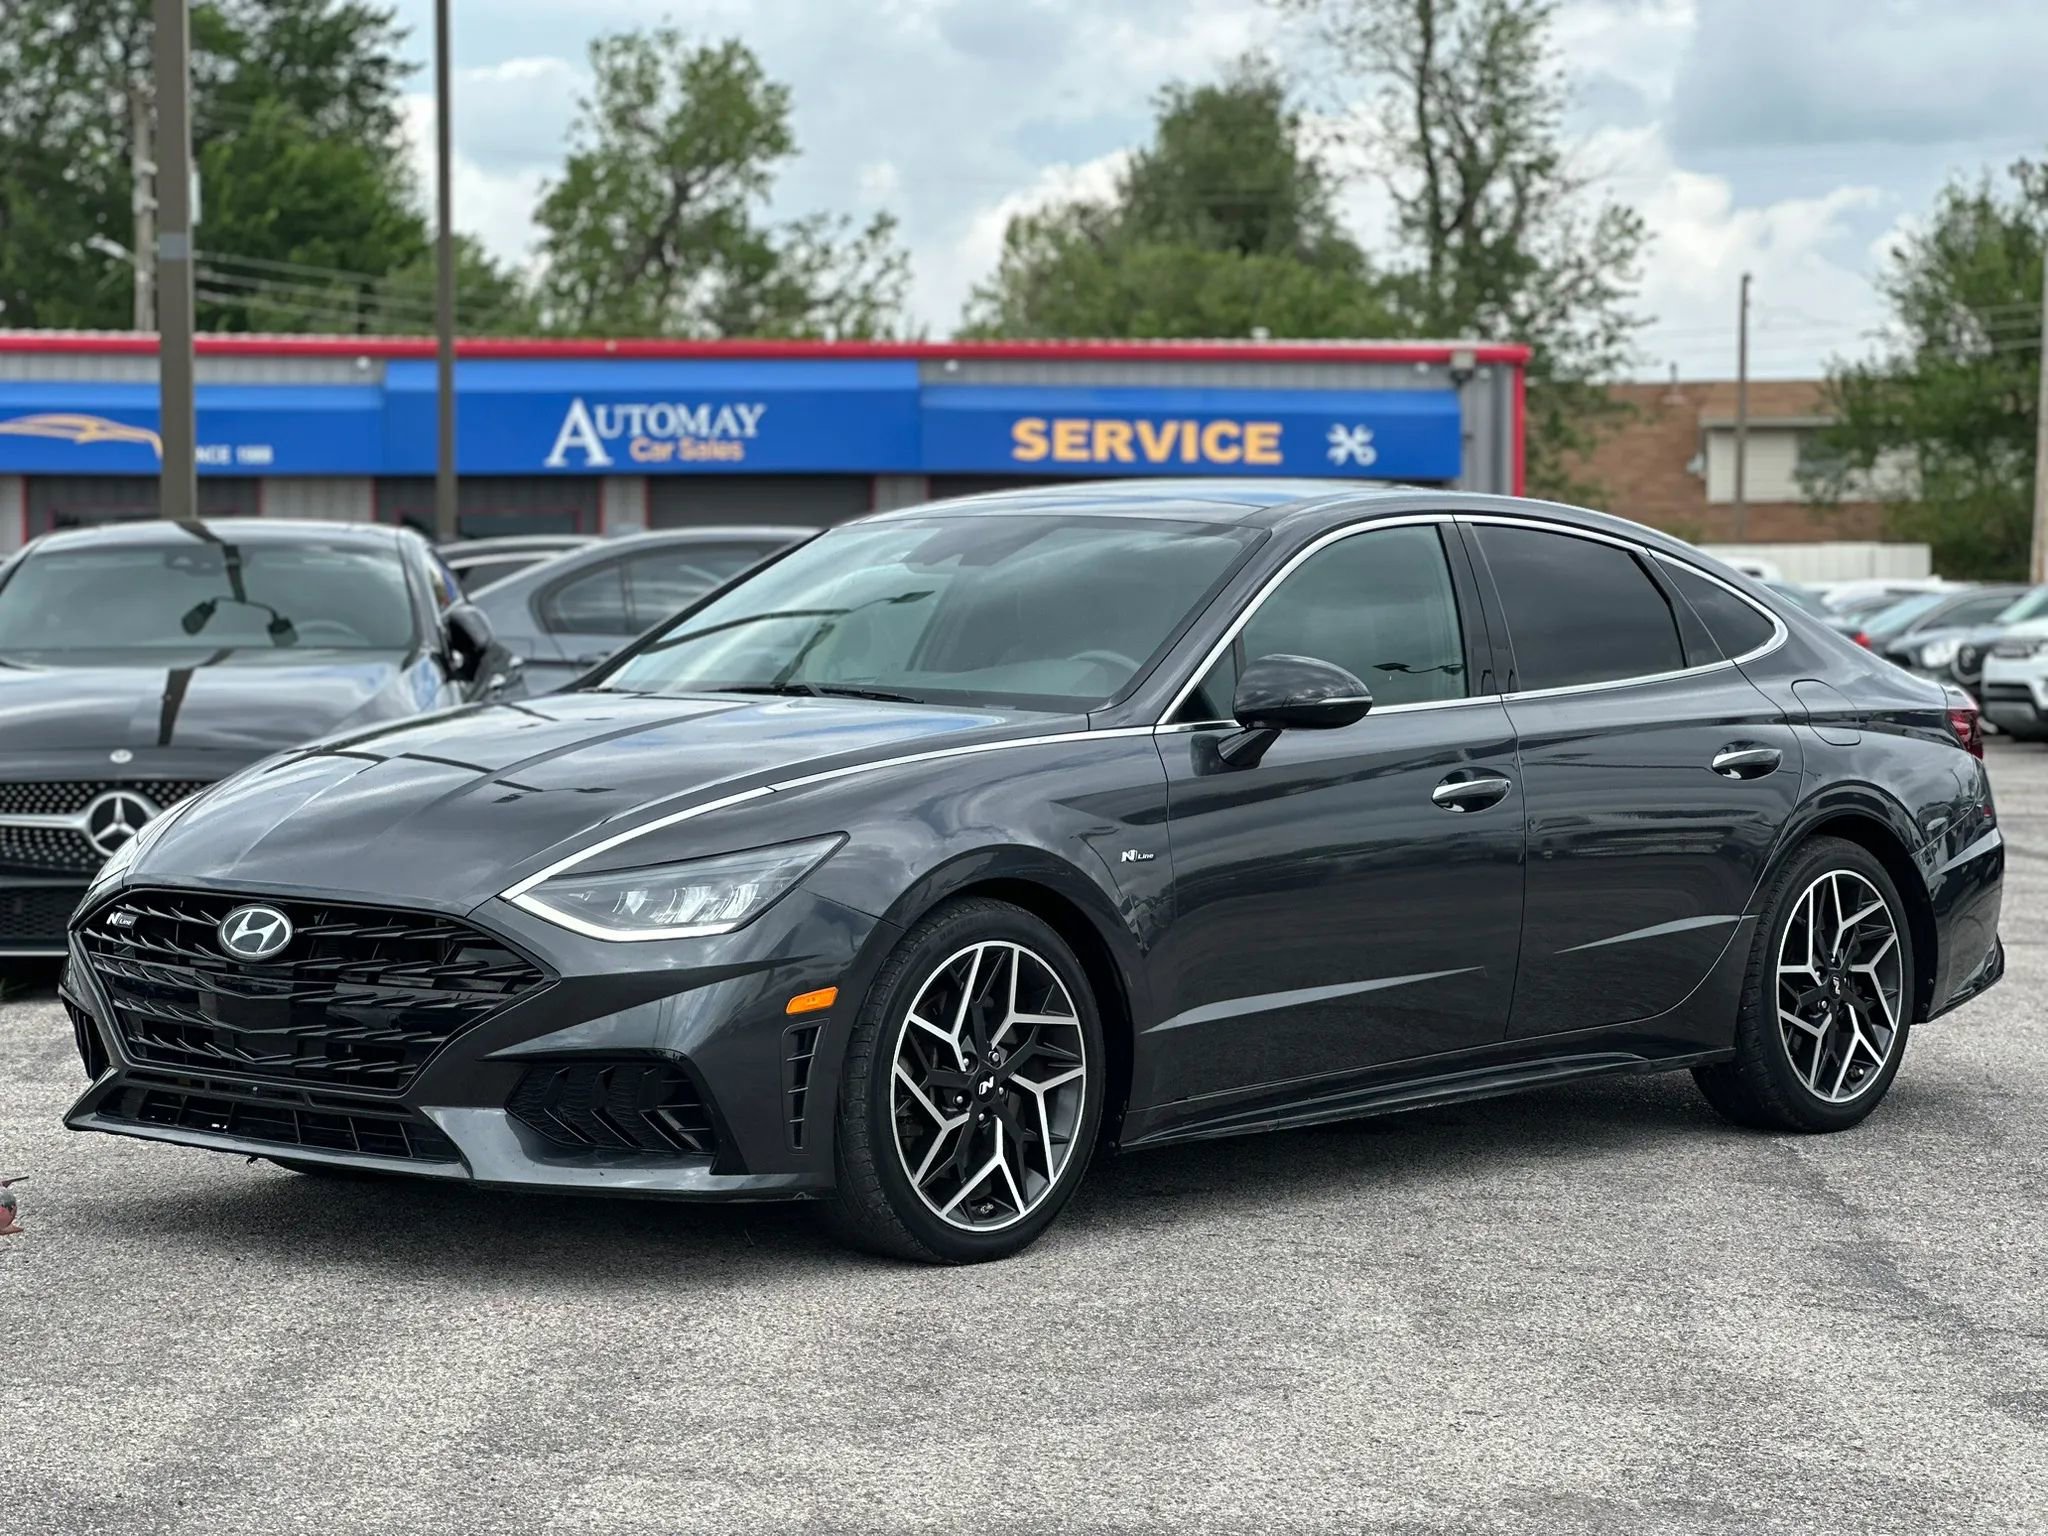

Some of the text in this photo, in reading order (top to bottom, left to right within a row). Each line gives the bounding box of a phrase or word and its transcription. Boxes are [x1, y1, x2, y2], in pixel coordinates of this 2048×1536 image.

[543, 398, 766, 467] AUTOMAY
[630, 436, 745, 462] Car Sales
[1012, 418, 1283, 464] SERVICE
